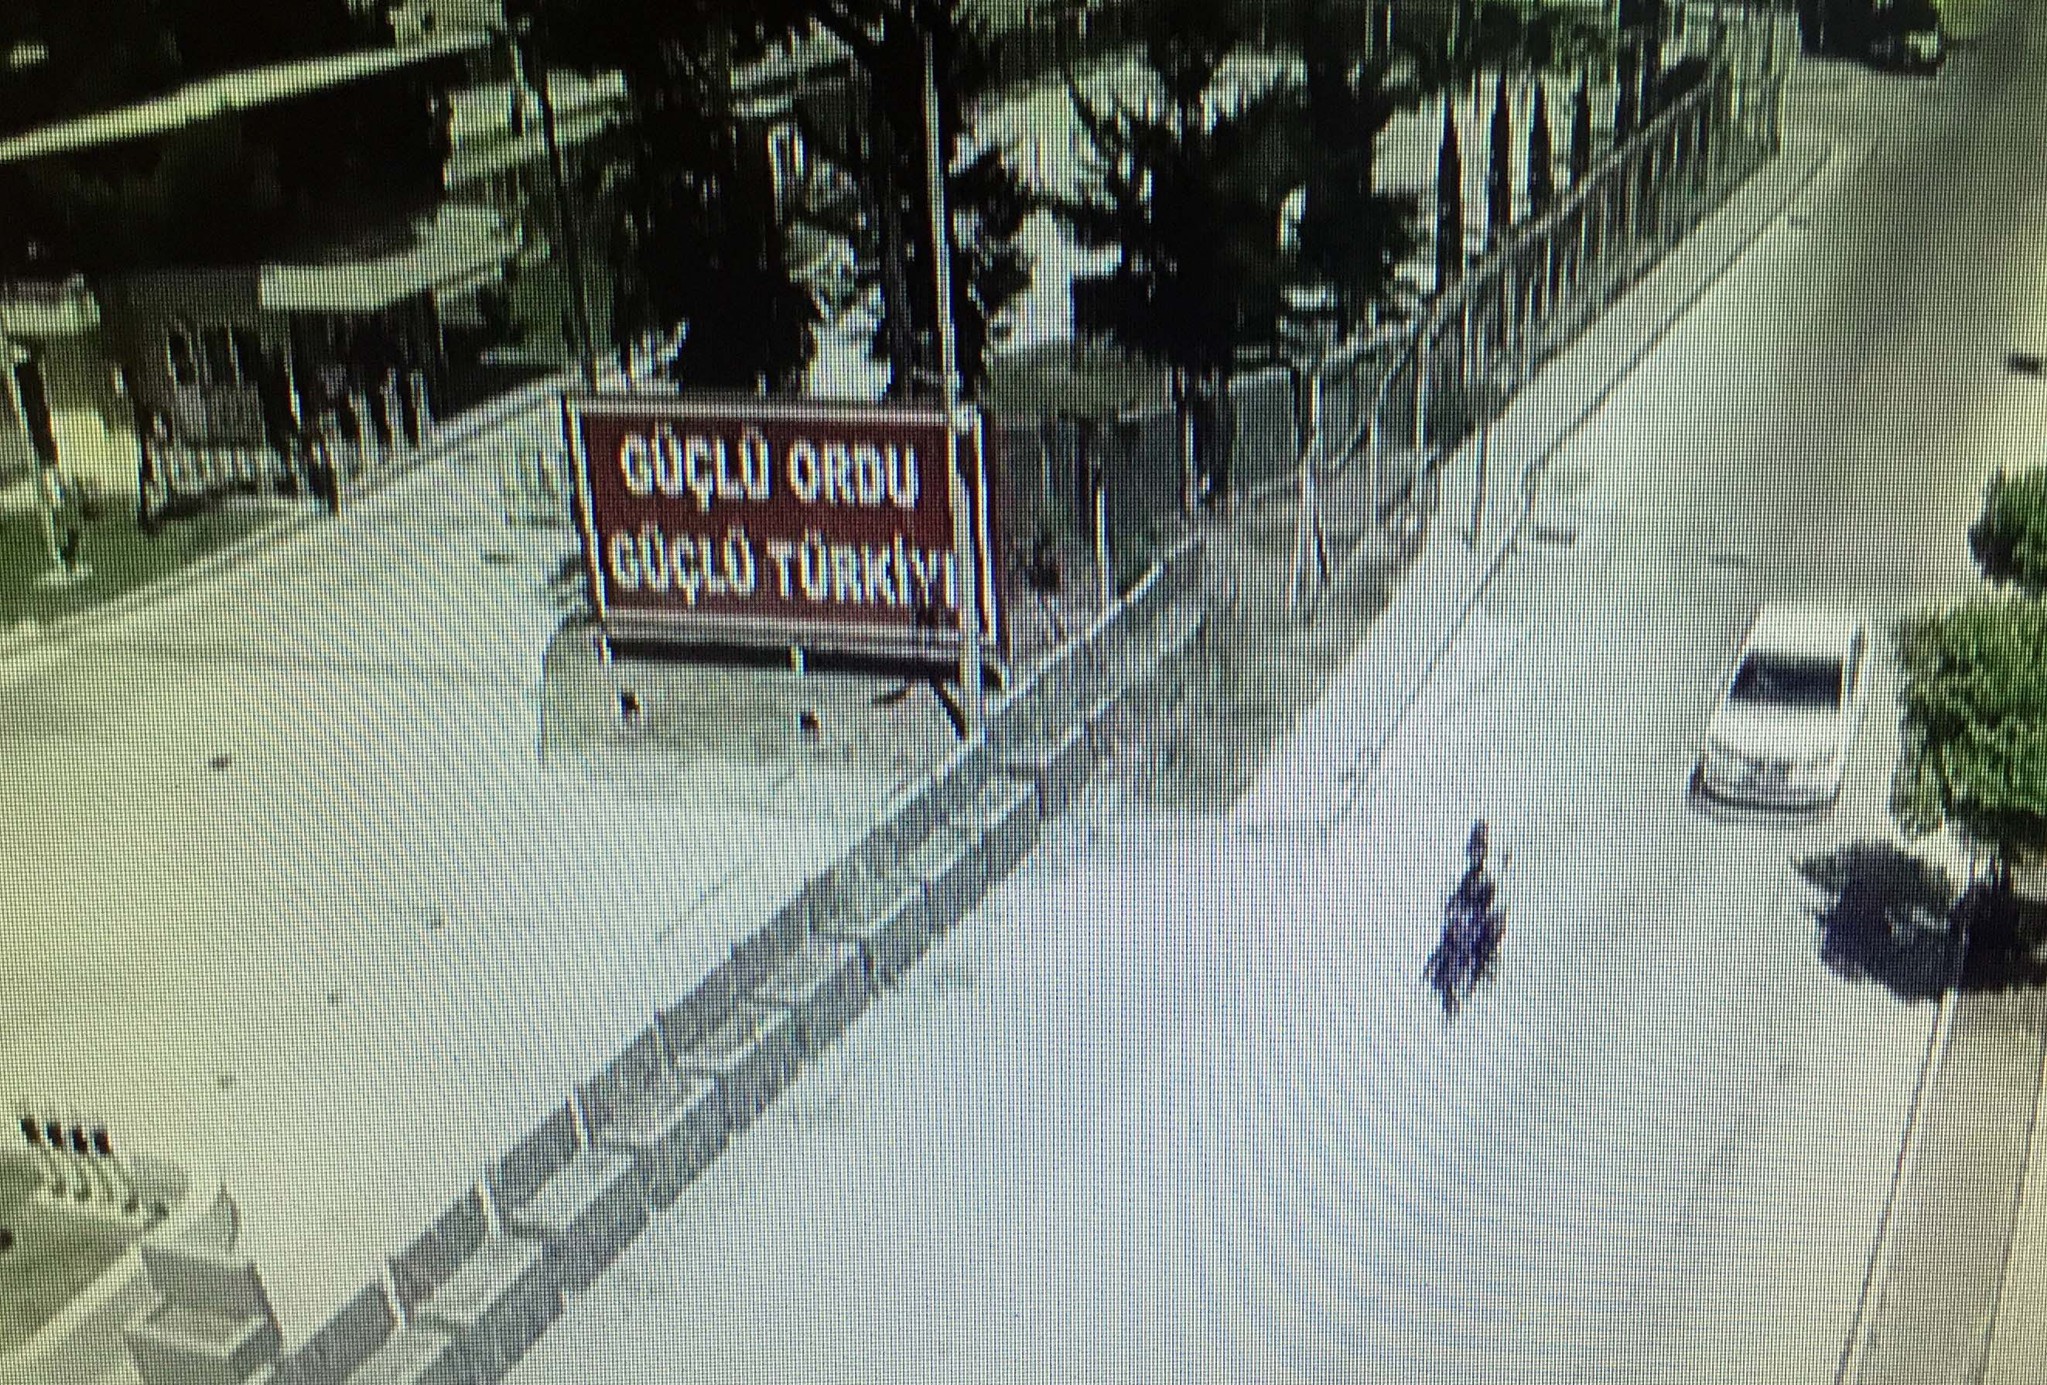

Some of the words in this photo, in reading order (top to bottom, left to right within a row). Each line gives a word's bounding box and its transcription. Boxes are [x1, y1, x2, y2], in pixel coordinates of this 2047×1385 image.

[619, 422, 772, 513] GÜÇLÜ
[787, 439, 920, 509] ORDU
[608, 520, 757, 607] GÜÇLÜ
